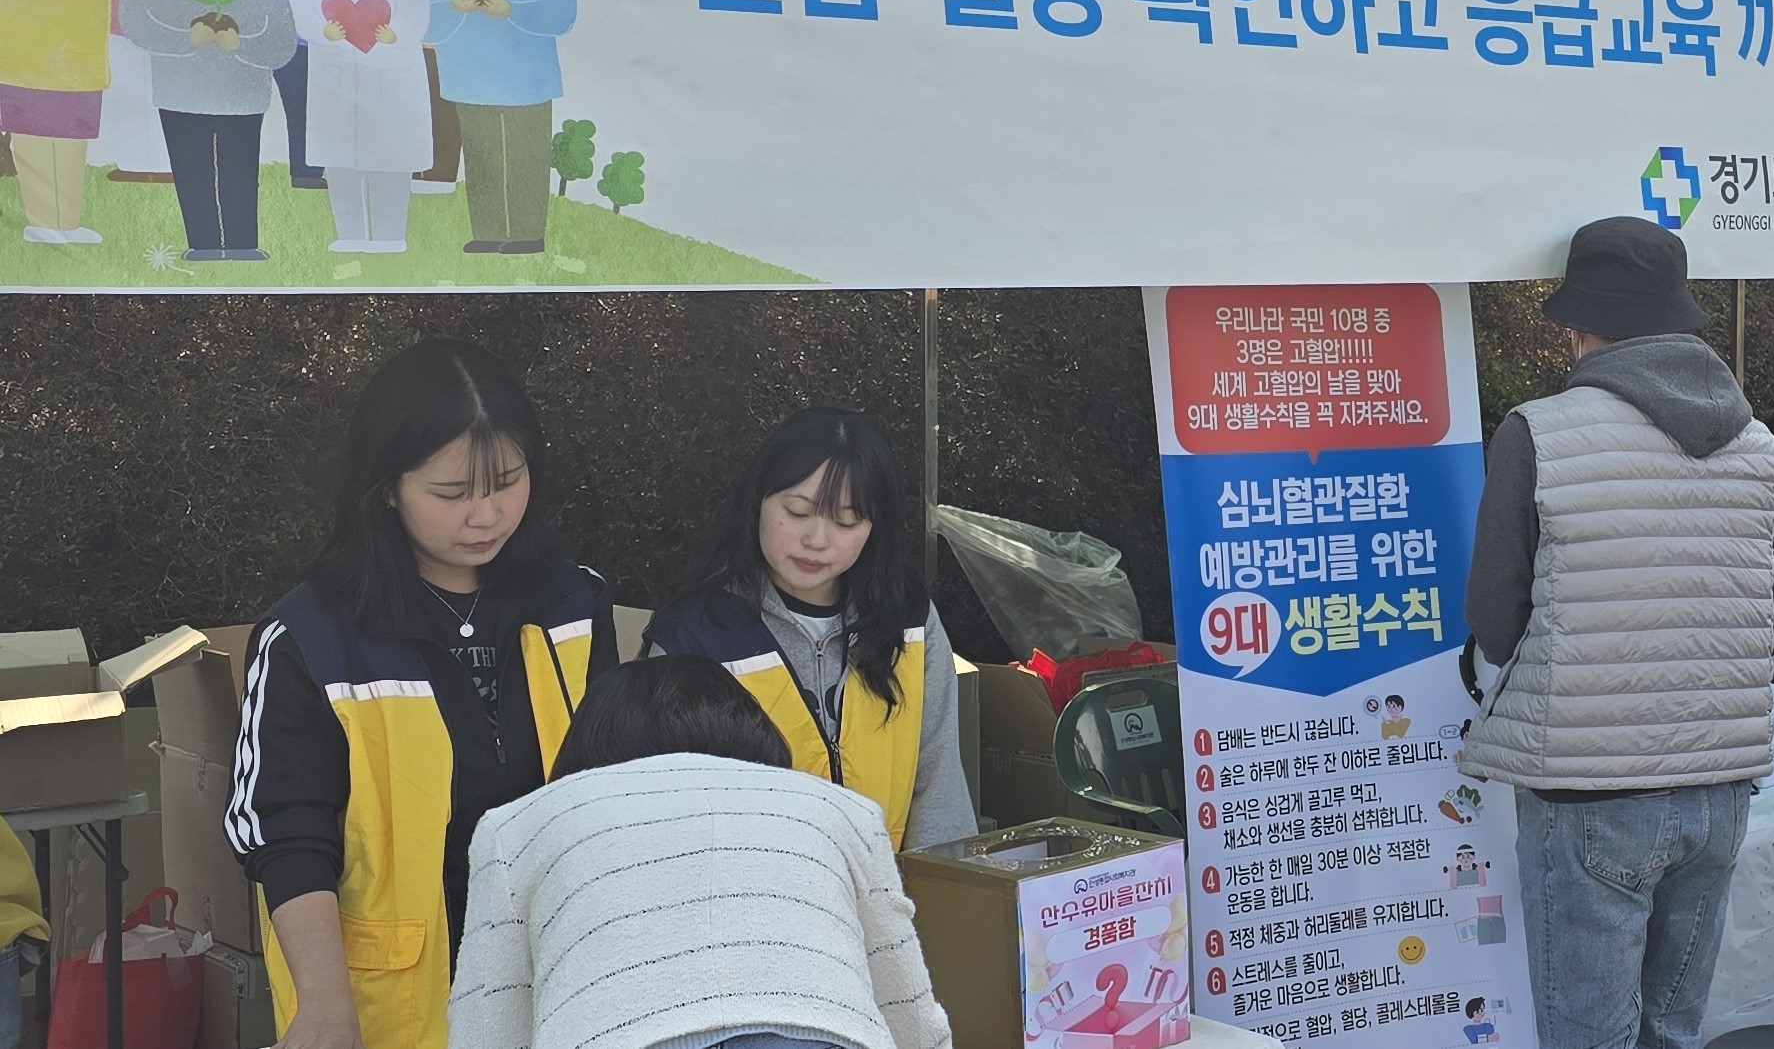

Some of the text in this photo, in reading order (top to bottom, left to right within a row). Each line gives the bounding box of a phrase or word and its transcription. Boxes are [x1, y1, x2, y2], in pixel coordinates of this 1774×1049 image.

[1712, 214, 1772, 230] GYEONGGI
[1215, 306, 1391, 334] 우리나라 국민 10명 중
[1236, 338, 1373, 366] 3명은 고혈압!!!!!
[1212, 369, 1401, 398] 세계 고혈압의 날을 맞아
[1187, 399, 1429, 431] 9대 생활수칙을 꼭 지켜주세요.
[1217, 472, 1409, 529] 심뇌혈관질환
[1200, 529, 1437, 591] 예방관리를 위한
[1207, 586, 1442, 656] 9대 생활수칙
[1198, 715, 1359, 752] 1 담배는 반드시 끊습니다.
[1199, 740, 1448, 789] 2 술은 하루에 한두 잔 이하로 줄입니다.
[1201, 782, 1382, 826] 3 음식은 싱겁게 골고루 먹고,
[1223, 804, 1428, 851] 채소와 생선을 충분히 섭취합니다.
[1205, 838, 1431, 889] 4 가능한 한 매일 30분 이상 적절한
[1041, 875, 1172, 928] 산수유마을잔치
[1226, 881, 1314, 916] 운동을 합니다.
[1084, 916, 1136, 950] 경품함
[1209, 898, 1449, 954] 5 적정 체중과 허리둘레를 유지합니다.
[1211, 948, 1345, 992] 6 스트레스를 줄이고,
[1233, 965, 1405, 1017] 즐거운 마음으로 생활합니다.
[1250, 992, 1461, 1042] 적으로 혈압, 혈당, 콜레스테롤을
